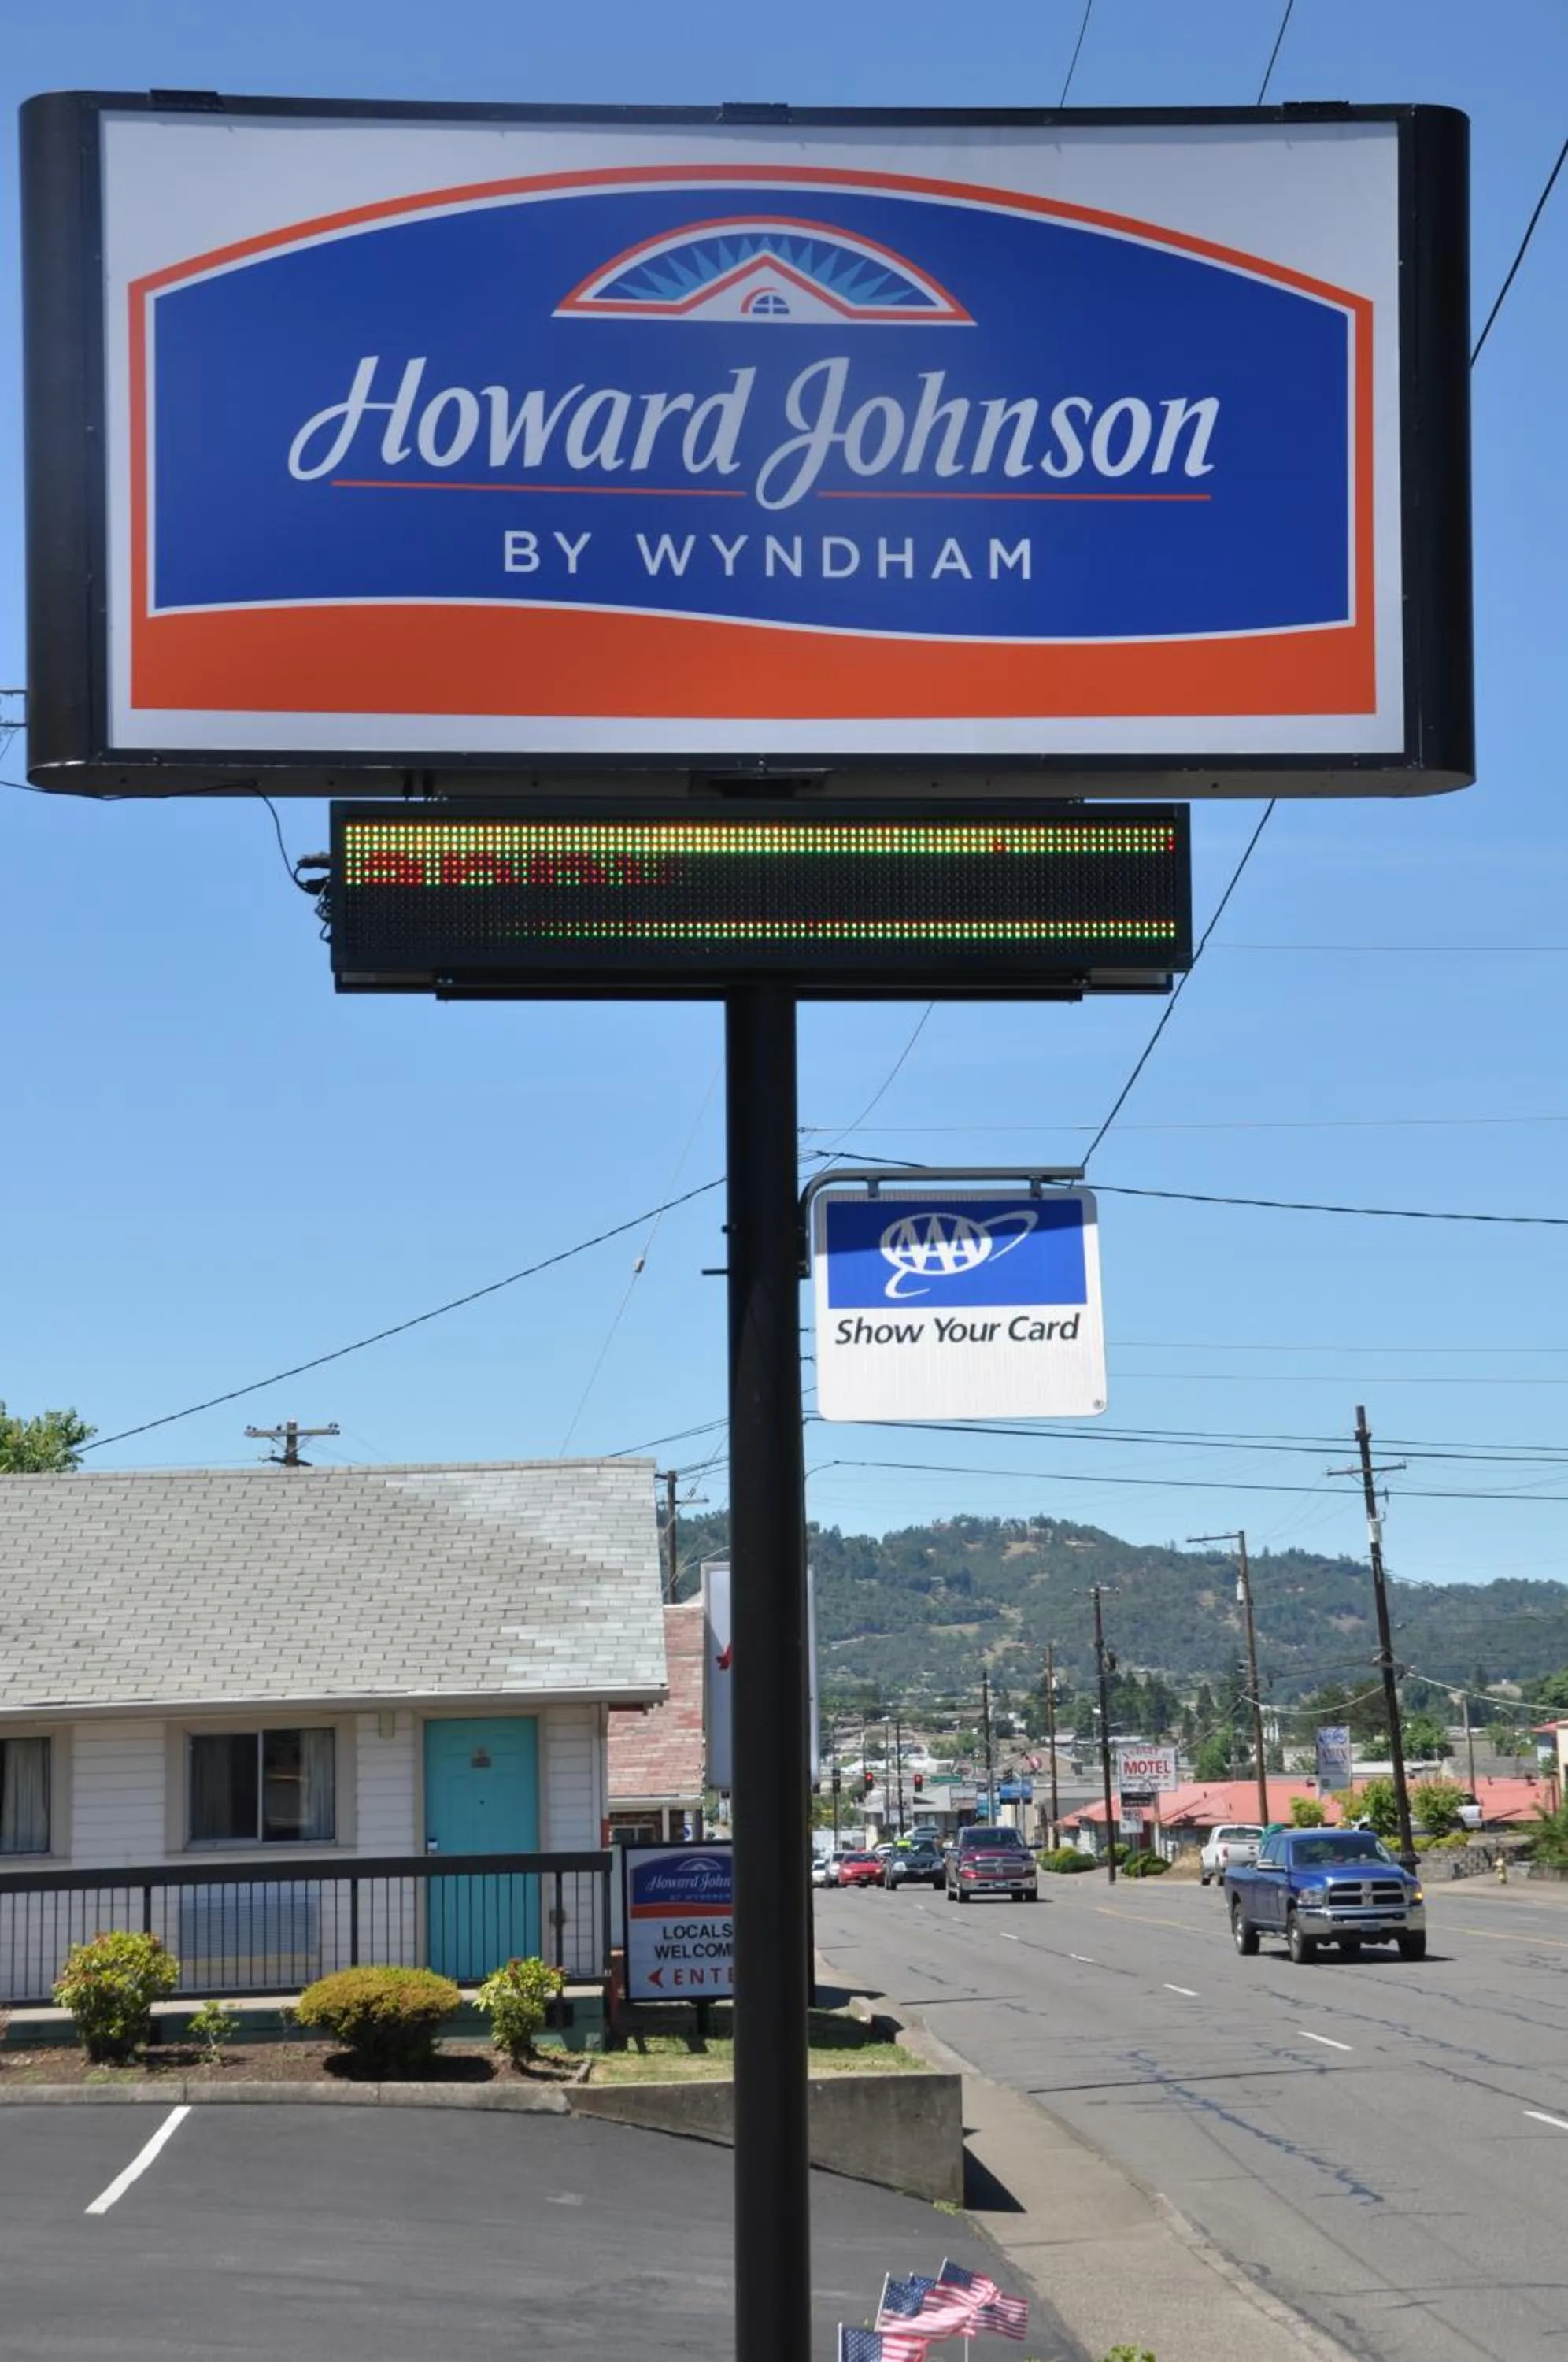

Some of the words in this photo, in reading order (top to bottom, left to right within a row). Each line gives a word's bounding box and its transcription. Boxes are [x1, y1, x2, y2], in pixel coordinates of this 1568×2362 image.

[288, 355, 756, 481] Howard
[755, 356, 1220, 510] Johnson
[503, 529, 592, 574] BY
[636, 533, 1032, 580] WYNDHAM
[889, 1215, 984, 1272] AAA
[834, 1316, 924, 1345] Show
[934, 1316, 1001, 1343] Your
[1008, 1312, 1082, 1342] Card
[1123, 1760, 1172, 1775] MOTEL
[645, 1875, 698, 1892] Howard
[699, 1872, 731, 1893] John
[662, 1923, 734, 1940] LOCALS
[654, 1942, 733, 1960] WELCOM
